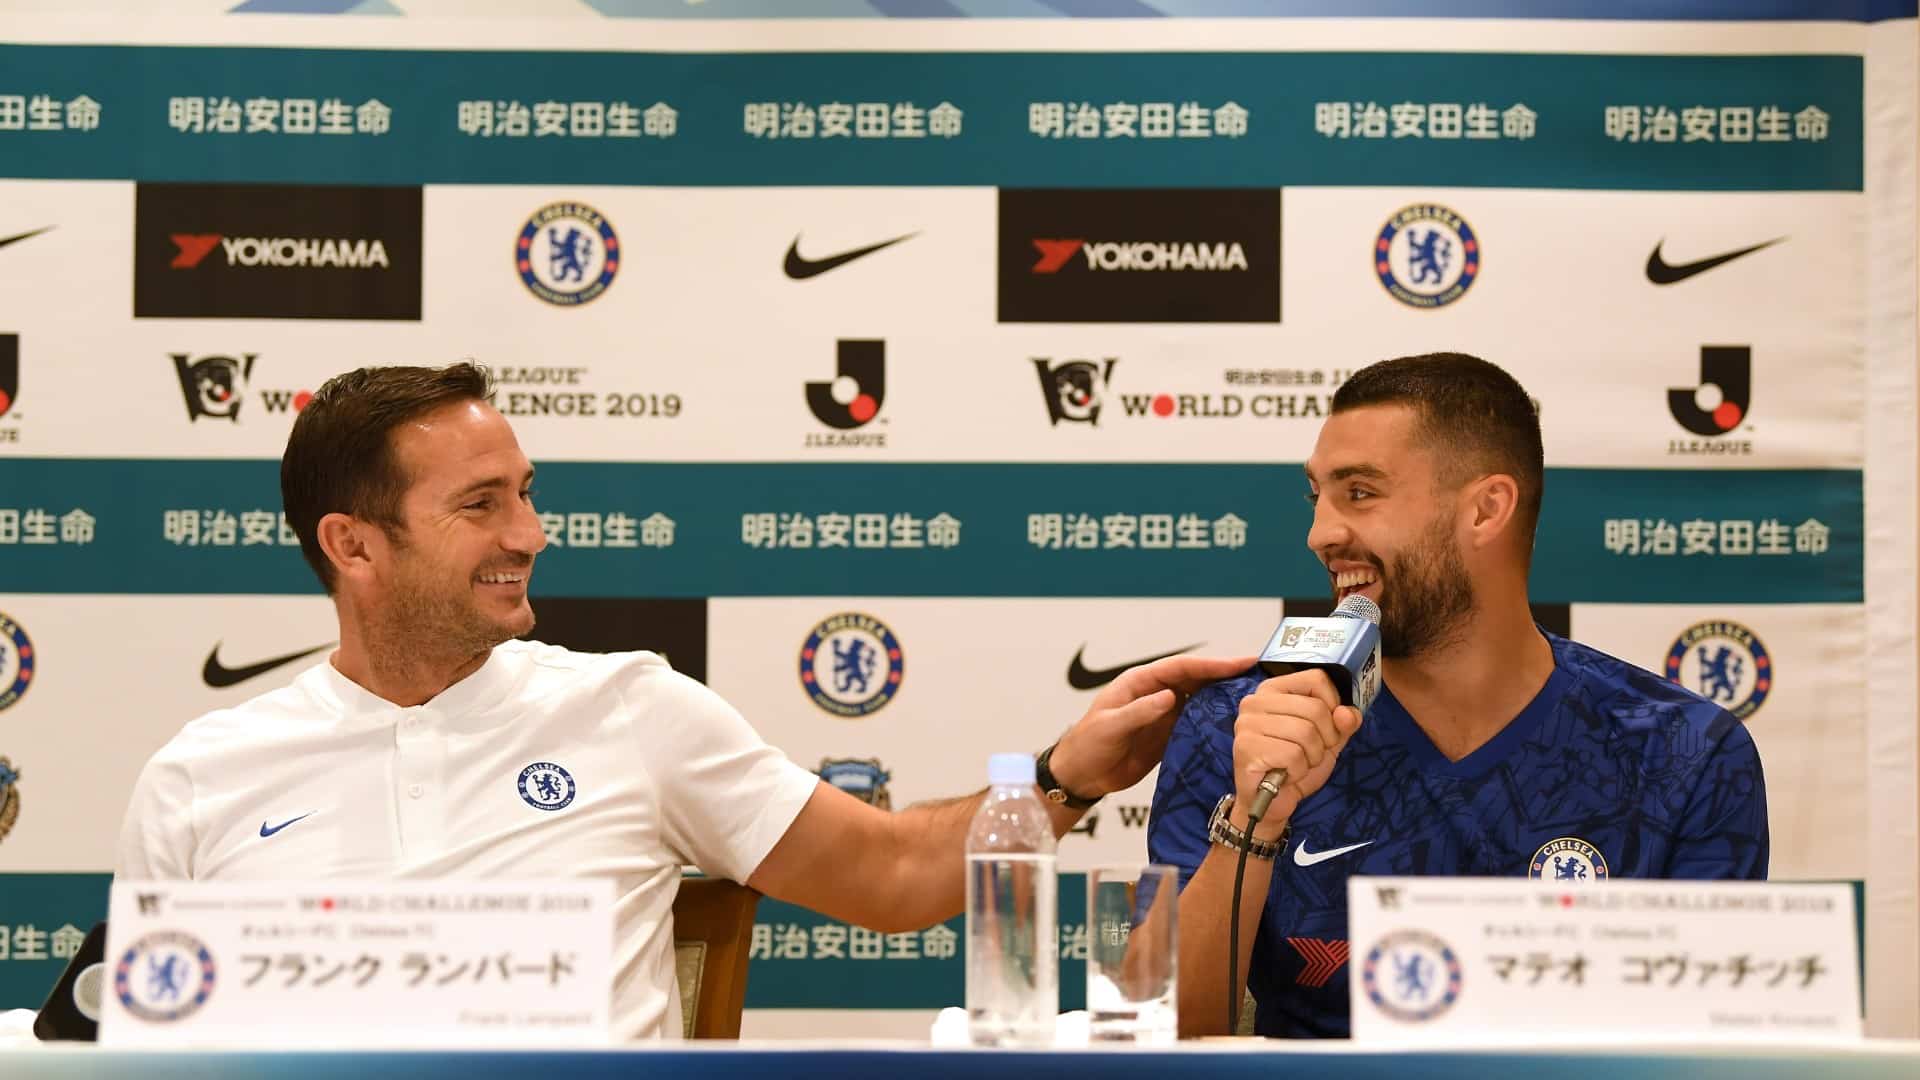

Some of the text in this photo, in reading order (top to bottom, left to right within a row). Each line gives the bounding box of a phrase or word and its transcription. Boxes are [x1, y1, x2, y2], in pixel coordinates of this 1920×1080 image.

[0, 94, 101, 131] 田生命
[168, 96, 391, 135] 明治安田生命
[457, 100, 678, 138] 明治安田生命
[743, 101, 963, 139] 明治安田生命
[1029, 101, 1249, 139] 明治安田生命
[1315, 101, 1537, 140] 明治安田生命
[1604, 105, 1829, 143] 明治安田生命
[222, 237, 389, 268] YOKOHAMA
[1082, 242, 1248, 271] YOKOHAMA
[607, 392, 682, 418] 2019
[1250, 394, 1332, 418] CHA
[741, 512, 962, 549] 明治安田生命
[1027, 512, 1248, 550] 明治安田生命
[1604, 518, 1830, 555] 明治安田生命
[522, 763, 561, 777] CHELSEA
[1543, 840, 1594, 859] CHELSEA
[0, 924, 86, 960] 生命
[241, 953, 383, 988] フランク
[1488, 954, 1588, 987] マテオ
